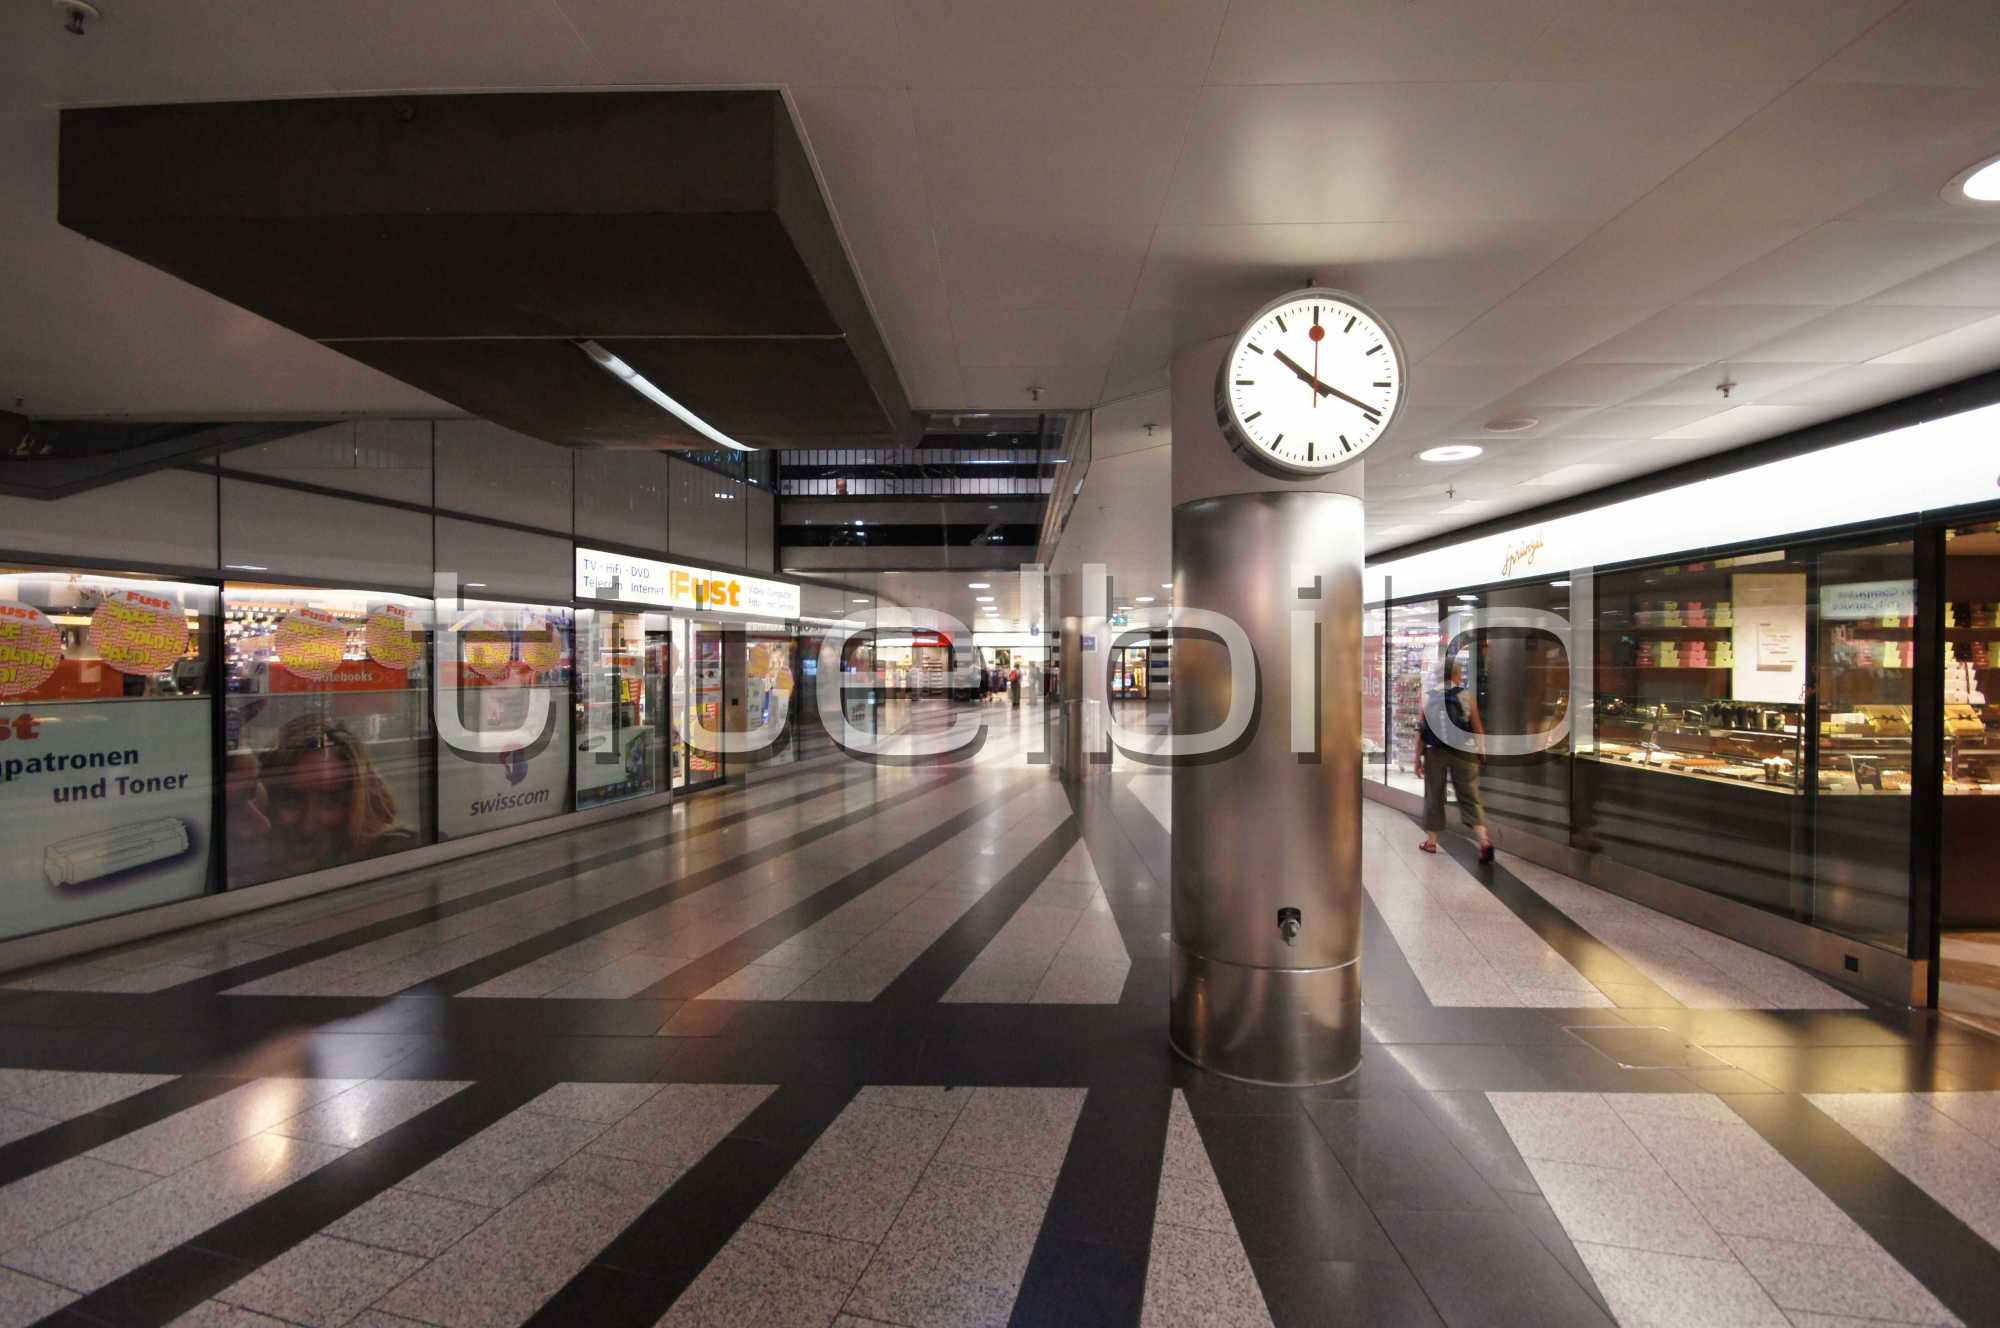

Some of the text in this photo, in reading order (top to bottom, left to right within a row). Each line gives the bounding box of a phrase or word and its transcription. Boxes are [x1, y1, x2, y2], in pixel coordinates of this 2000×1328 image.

[631, 566, 650, 579] DVD
[584, 575, 664, 596] Telecom Internet
[668, 569, 742, 608] Fust
[127, 591, 173, 609] Fust
[0, 604, 41, 621] ust
[0, 748, 139, 781] patronen
[53, 772, 189, 804] und Toner
[470, 789, 550, 817] swisscom
